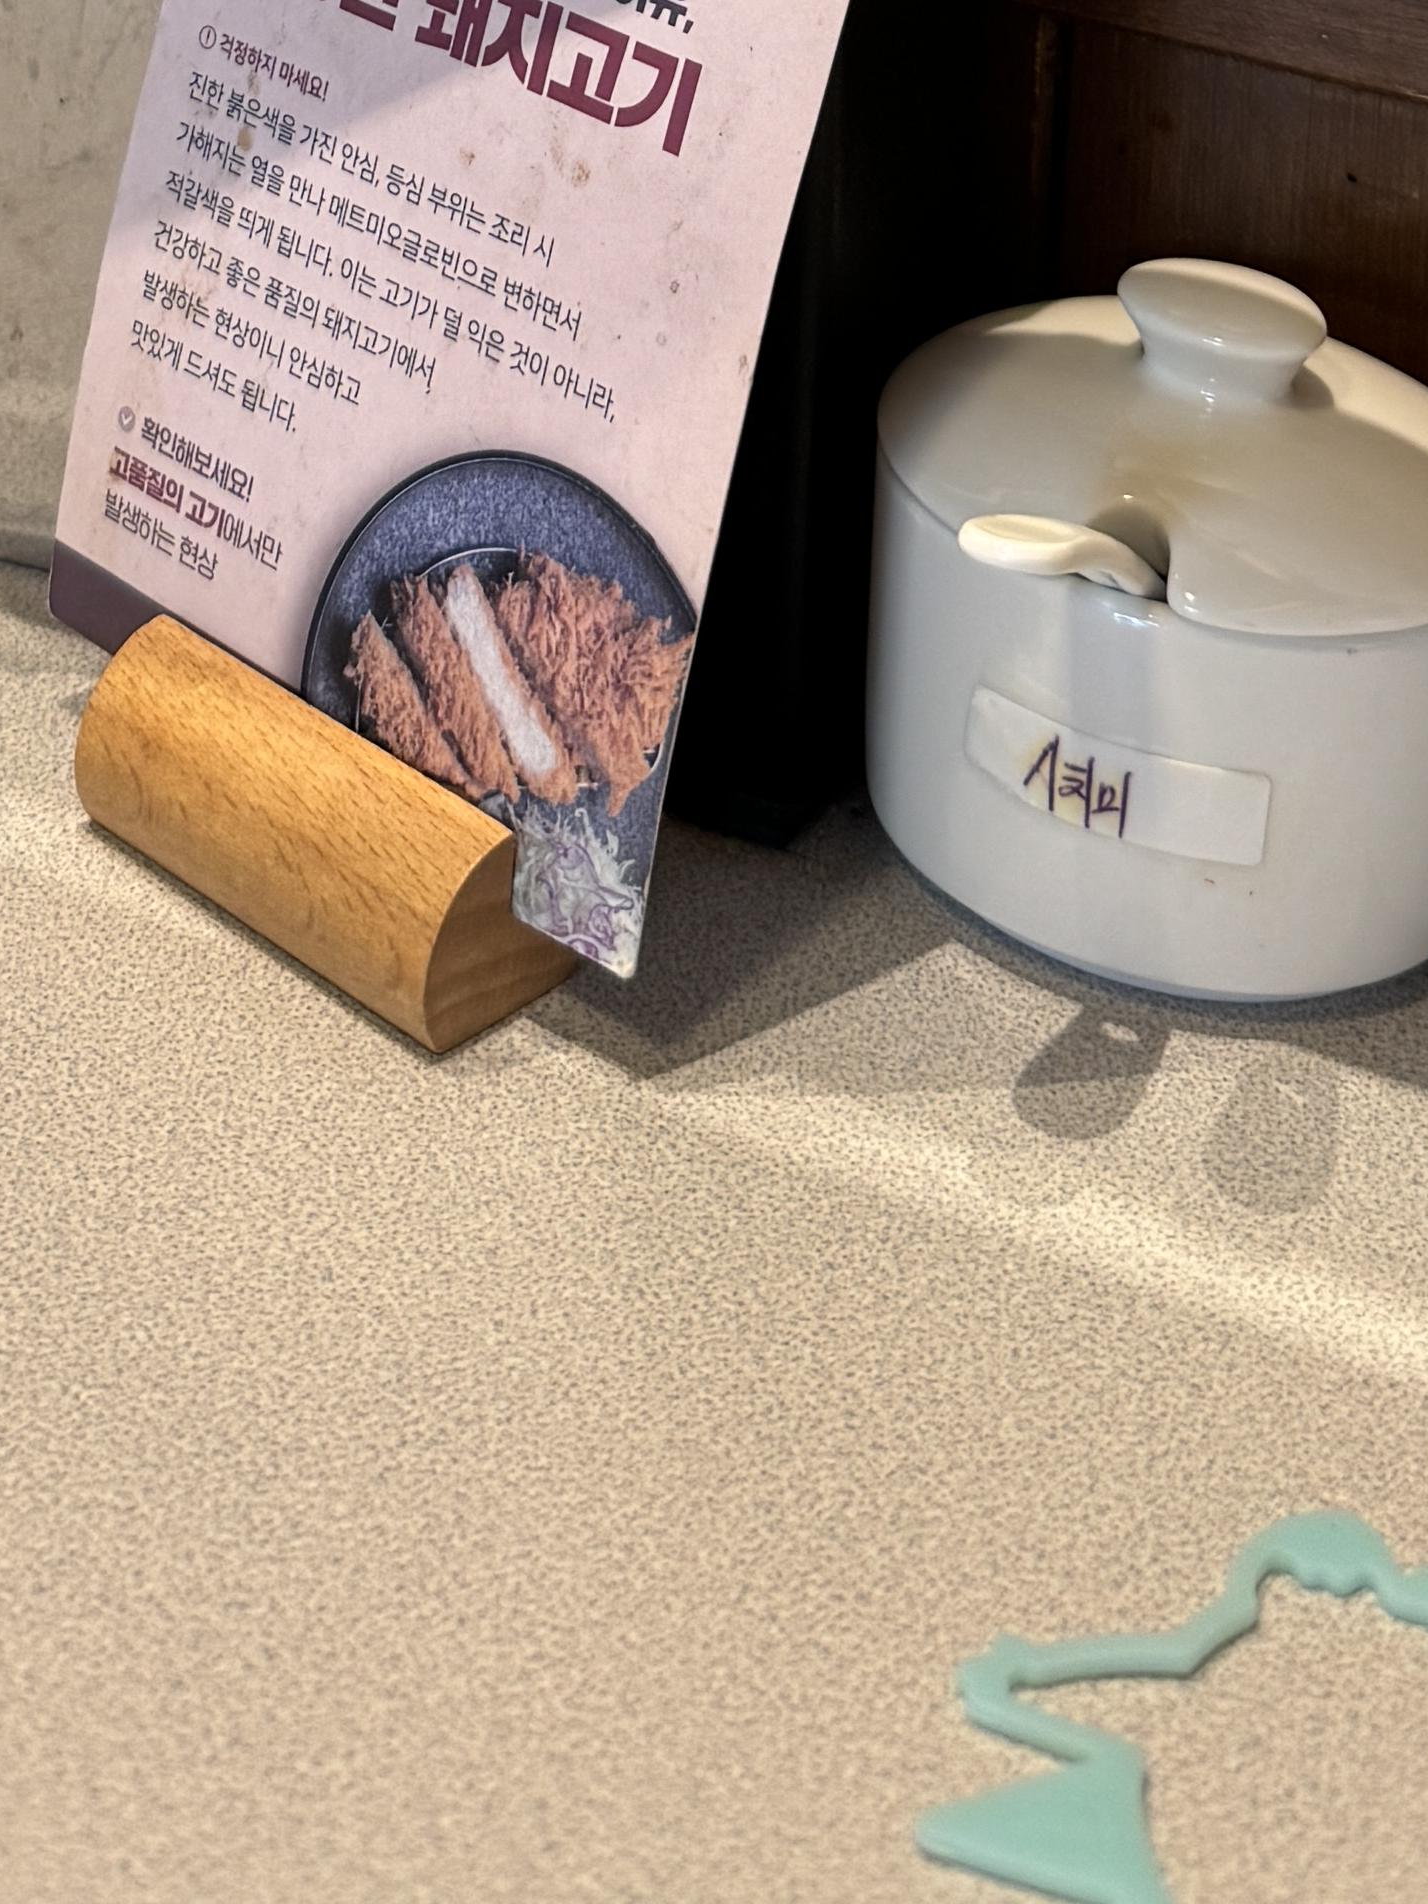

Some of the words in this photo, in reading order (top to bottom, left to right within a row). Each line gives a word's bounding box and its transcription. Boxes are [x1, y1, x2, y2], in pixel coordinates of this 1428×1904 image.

[220, 33, 277, 80] 걱정하지
[279, 61, 329, 102] 마세요!
[189, 71, 225, 111] 진한
[226, 88, 296, 146] 붉은색을
[299, 125, 337, 164] 가진
[386, 163, 425, 206] 등심
[428, 183, 486, 234] 부위는
[488, 212, 531, 257] 조리
[533, 234, 555, 268] 시
[154, 221, 223, 275] 건강하고
[225, 255, 261, 299] 좋은
[264, 277, 321, 329] 품질의
[176, 121, 246, 177] 가해지는
[251, 155, 285, 196] 열을
[289, 174, 326, 217] 만나
[327, 194, 498, 297] 메트미오글로빈으로
[504, 277, 582, 342] 변하면서
[142, 269, 211, 328] 발생하는
[215, 307, 286, 368] 현상이니
[289, 347, 362, 406] 안심하고
[166, 171, 235, 228] 적갈색을
[237, 206, 275, 248] 띄게
[277, 226, 334, 277] 됩니다.
[340, 257, 377, 299] 이는
[379, 278, 439, 329] 고기가
[443, 307, 463, 342] 덜
[468, 319, 505, 363] 익은
[509, 341, 550, 386] 것이
[553, 363, 615, 422] 아니라,
[131, 319, 184, 371] 맛있게
[183, 348, 237, 397] 드셔도
[240, 378, 297, 433] 됩니다.
[109, 445, 185, 514] 고품질의
[185, 491, 283, 571] 고기에서만
[141, 416, 255, 503] 확인해보세요!
[104, 488, 176, 556] 발생하는
[178, 534, 219, 581] 현상
